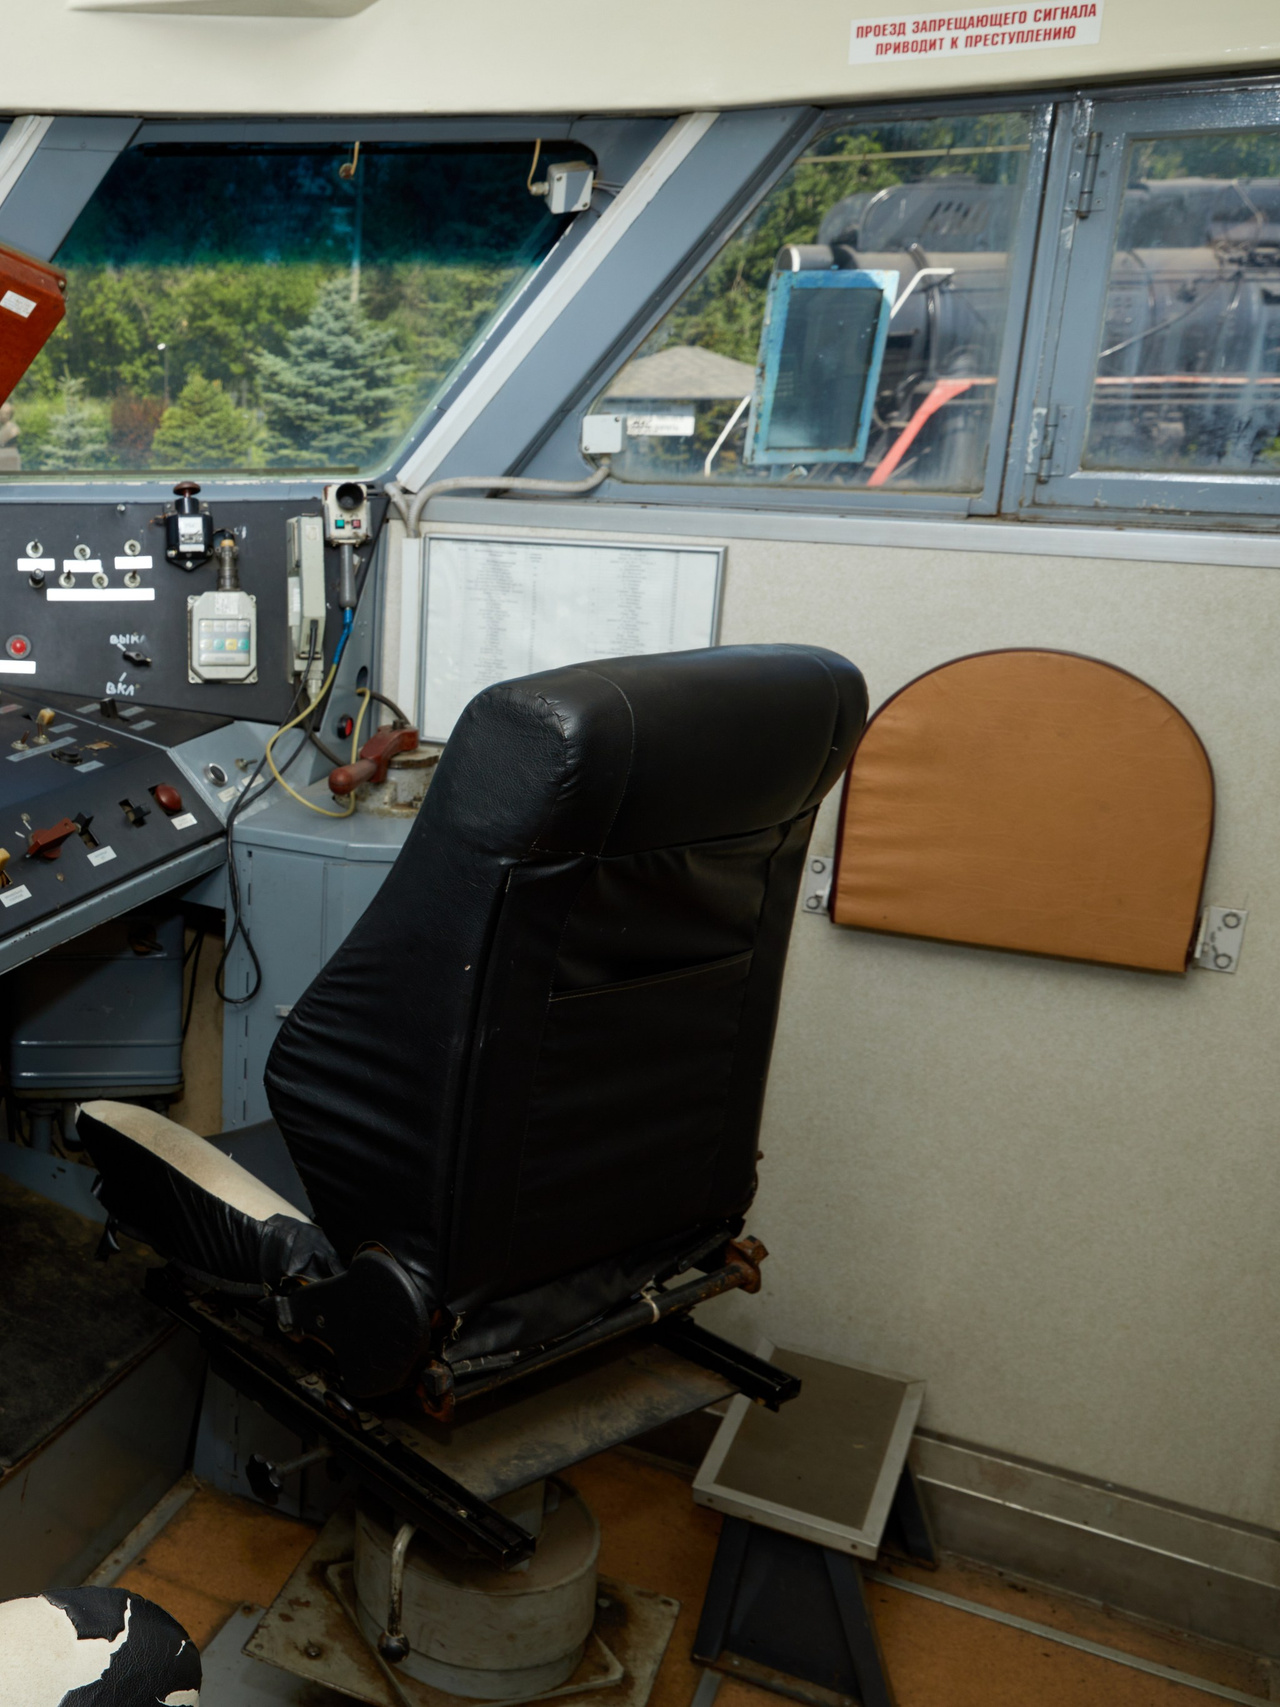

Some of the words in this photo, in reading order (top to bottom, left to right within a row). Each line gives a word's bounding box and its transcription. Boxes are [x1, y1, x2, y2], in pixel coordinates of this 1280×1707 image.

[856, 21, 906, 39] ПРОЕЗД
[912, 10, 1028, 34] ЗАПРЕЩАЮЩЕГО
[1033, 3, 1097, 23] СИГНАЛА
[875, 37, 945, 56] ПРИВОДИТ
[950, 35, 959, 49] К
[964, 25, 1077, 49] ПРЕСТУПЛЕНИЮ
[105, 681, 135, 697] ВКЛ
